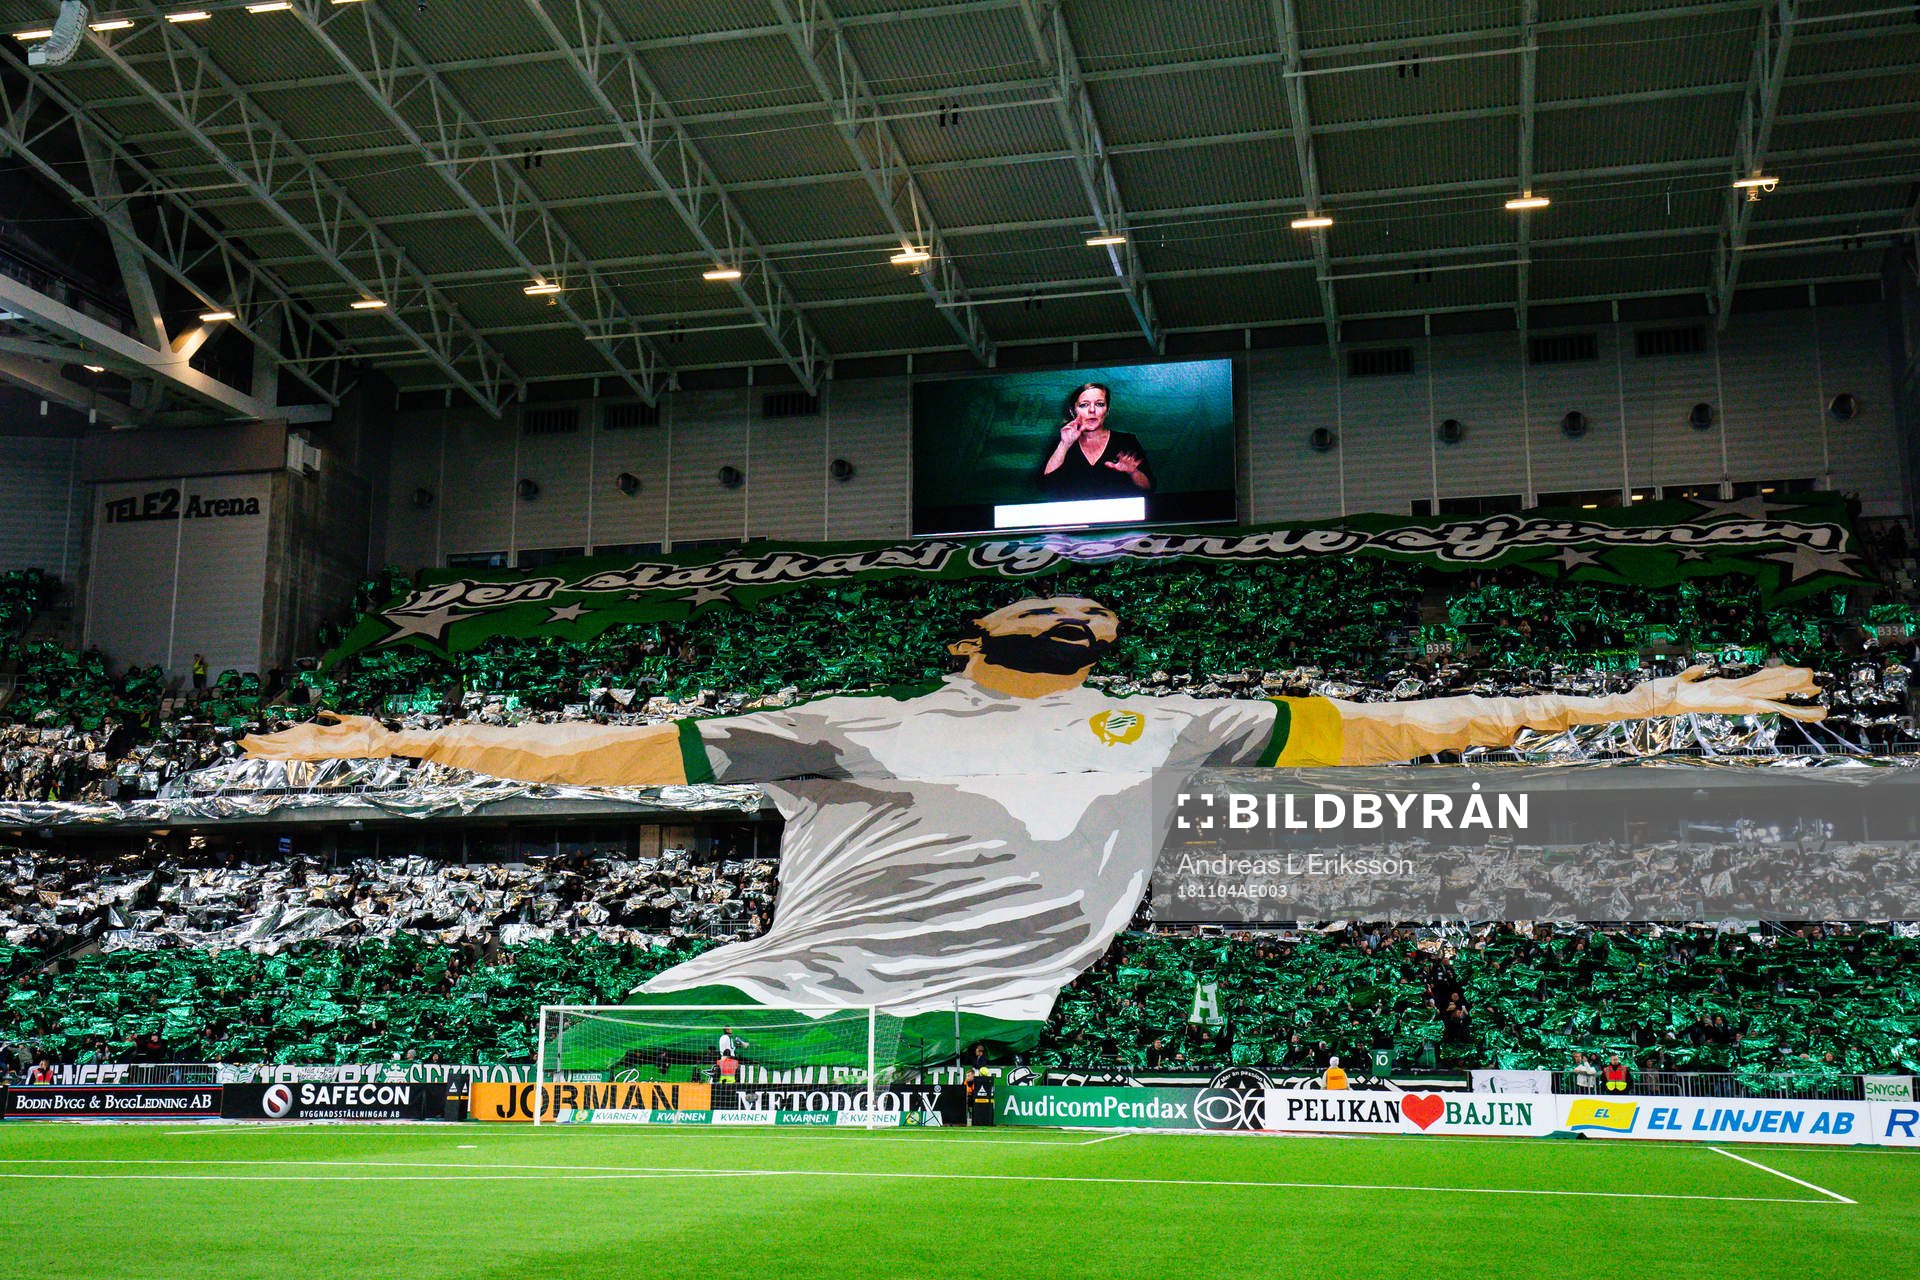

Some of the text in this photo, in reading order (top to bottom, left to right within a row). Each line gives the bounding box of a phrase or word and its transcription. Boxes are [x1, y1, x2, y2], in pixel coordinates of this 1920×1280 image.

[104, 488, 261, 523] TELE2 Arena
[394, 579, 560, 615] Den
[572, 541, 960, 592] starkast
[1388, 517, 1842, 560] stjärnan
[1425, 643, 1452, 654] B335
[1376, 1054, 1389, 1066] 10
[300, 1083, 411, 1106] SAFECON
[1865, 1082, 1910, 1097] SNYGGA
[16, 1094, 212, 1109] BODIN BYGG & BYGGLEDNING AB
[736, 1091, 942, 1112] METODGOLV
[1003, 1095, 1188, 1119] AudicomPendax
[300, 1109, 400, 1118] BYGGNADSSTÄLLNINGAR AB
[595, 1111, 638, 1121] KVARNEN
[656, 1112, 706, 1121] KVARNEN
[720, 1113, 768, 1122] KVARNEN
[782, 1113, 830, 1122] KVARNEN
[1287, 1098, 1533, 1126] PELIKAN BAJEN
[1594, 1108, 1610, 1118] EL
[1647, 1107, 1855, 1135] EL LINJEN AB
